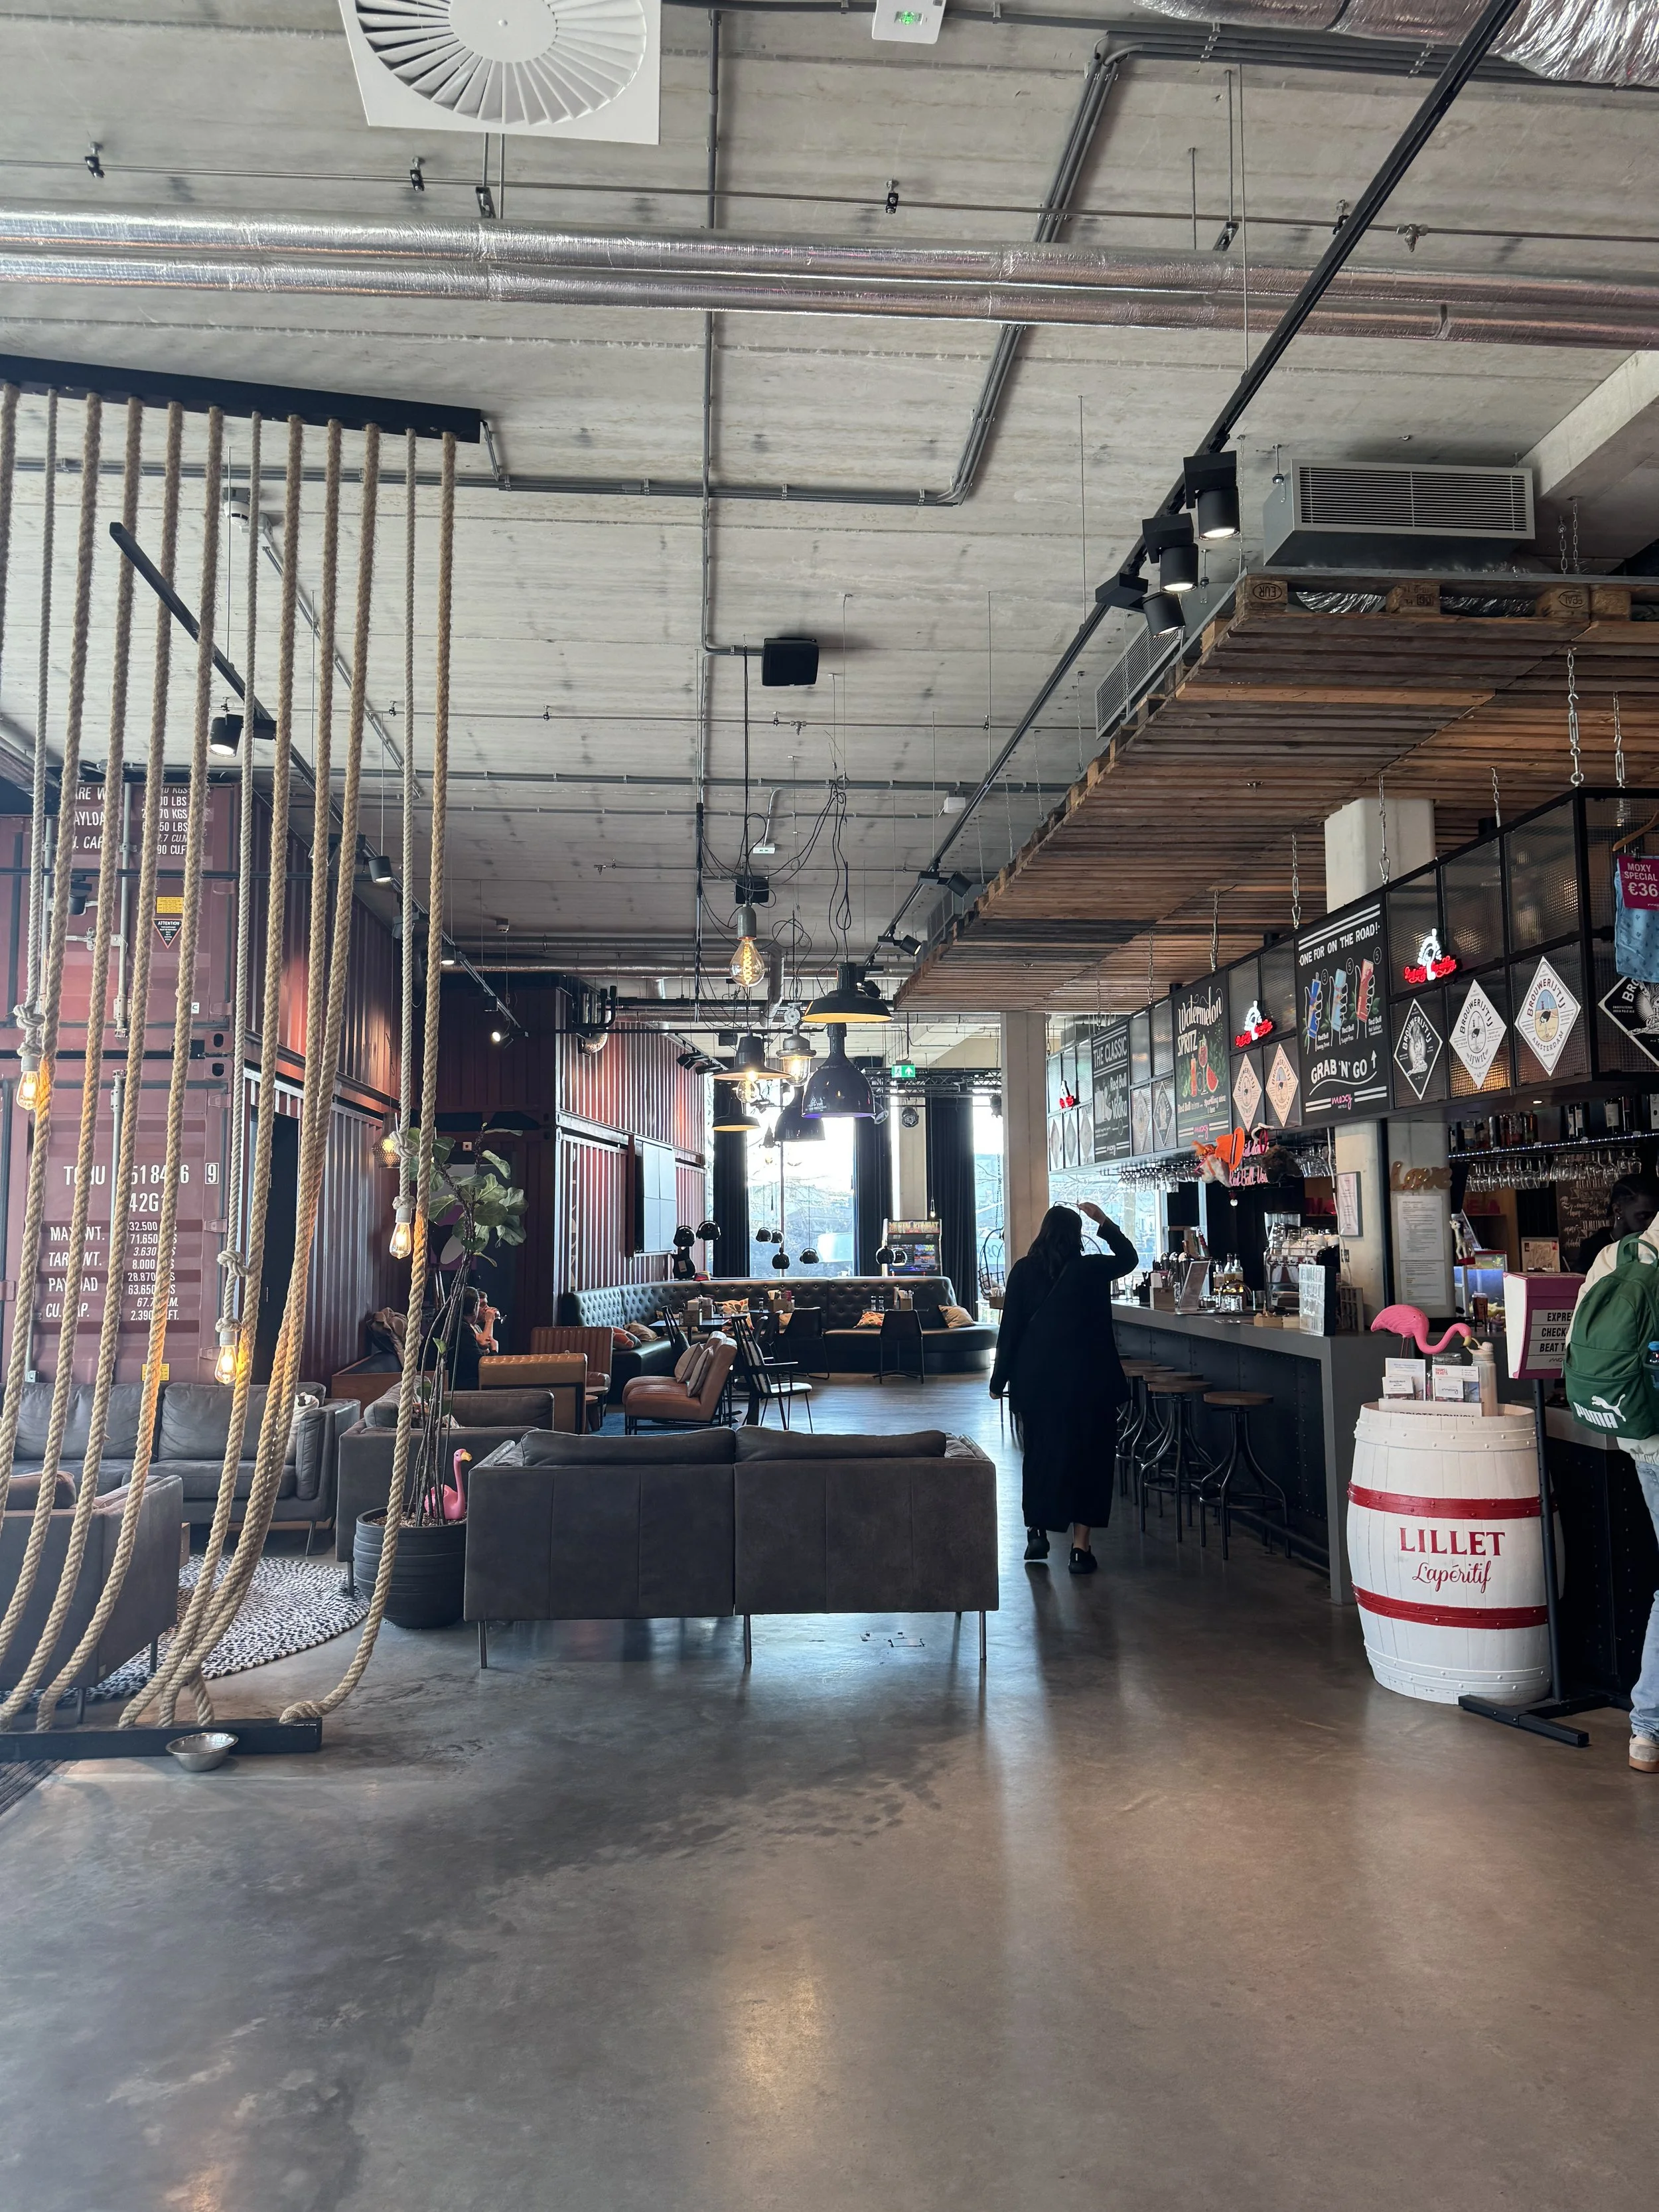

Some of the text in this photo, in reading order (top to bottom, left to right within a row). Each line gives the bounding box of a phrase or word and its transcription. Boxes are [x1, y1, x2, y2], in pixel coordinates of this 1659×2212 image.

[1259, 586, 1276, 597] EUR
[172, 796, 186, 806] LBS
[173, 809, 188, 819] KGS
[173, 822, 188, 832] LBS
[1624, 871, 1658, 881] SPECIAL
[1627, 863, 1651, 872] MOXY
[1628, 882, 1658, 897] €36
[1300, 951, 1313, 966] ONE
[1313, 945, 1325, 960] FOR
[1327, 939, 1338, 954] ON
[1340, 932, 1354, 948] THE
[1178, 986, 1222, 1034] Watermelon
[1177, 1029, 1197, 1057] SPRITZ
[1532, 1030, 1564, 1051] AMSTERDAM
[1094, 1037, 1127, 1068] THE CLASSIC
[1311, 1059, 1337, 1084] GRAB
[1352, 1059, 1368, 1078] GO
[1112, 1095, 1127, 1120] Vodka
[1331, 1094, 1352, 1110] moxy
[45, 1303, 61, 1318] CU.
[1540, 1343, 1559, 1353] BEAT
[1573, 1401, 1619, 1428] PUMA
[1400, 1527, 1506, 1556] LILLET
[1412, 1560, 1492, 1594] L'apéritif
